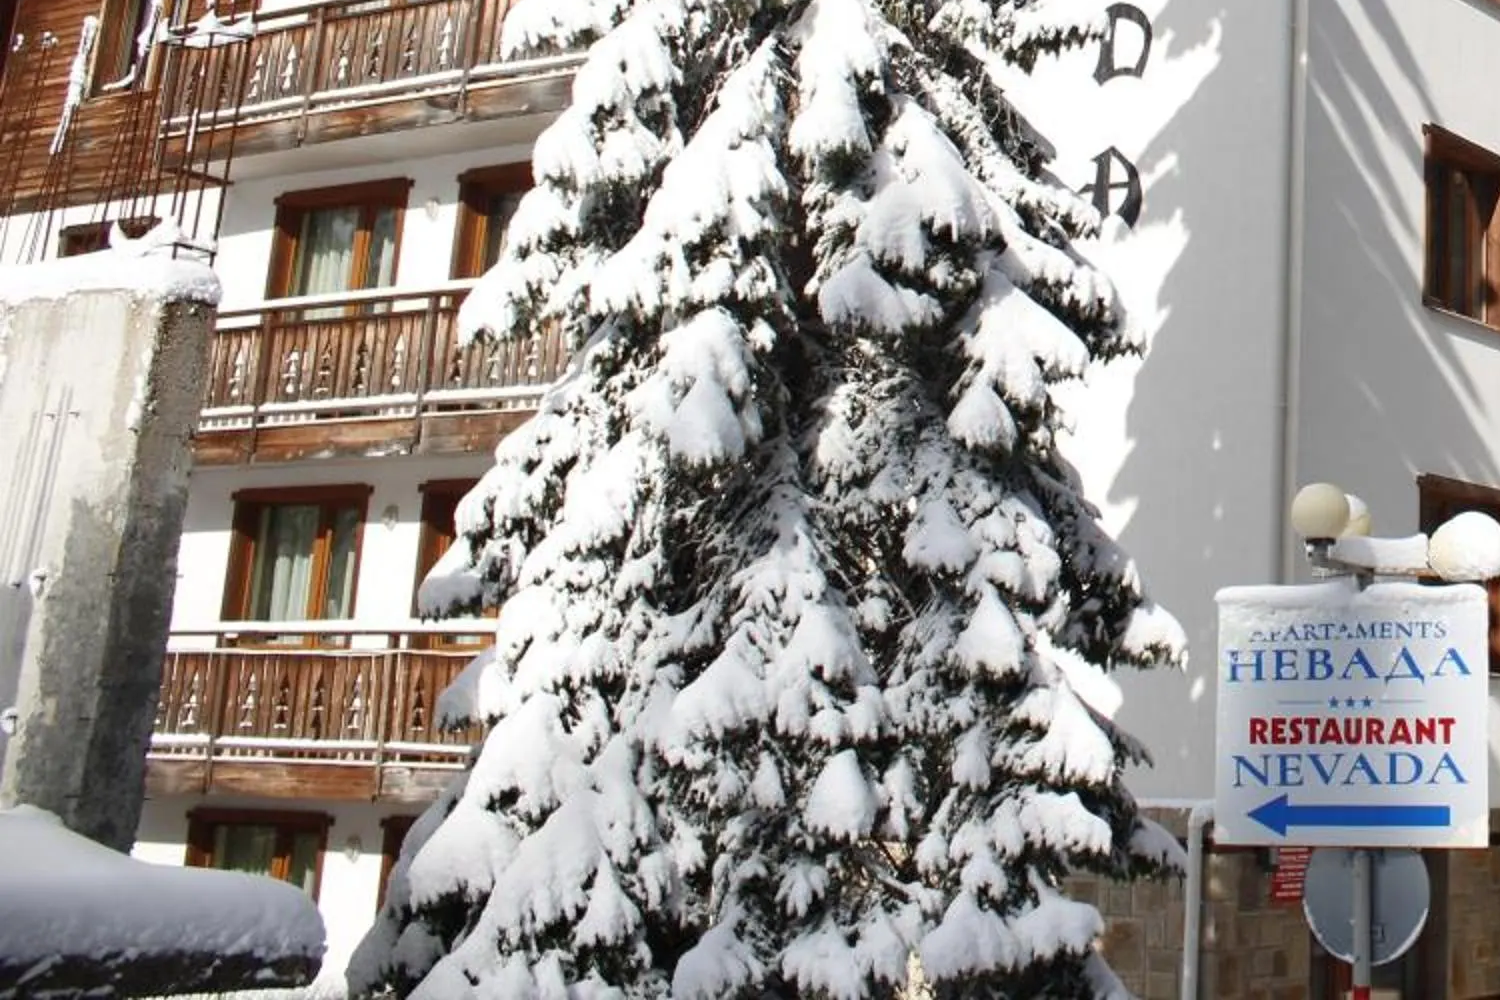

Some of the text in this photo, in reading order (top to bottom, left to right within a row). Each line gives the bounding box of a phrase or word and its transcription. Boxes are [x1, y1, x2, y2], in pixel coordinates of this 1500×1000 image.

[1226, 647, 1472, 685] НЕВАДА
[1249, 716, 1457, 745] RESTAURANT
[1231, 751, 1470, 788] NEVADA
